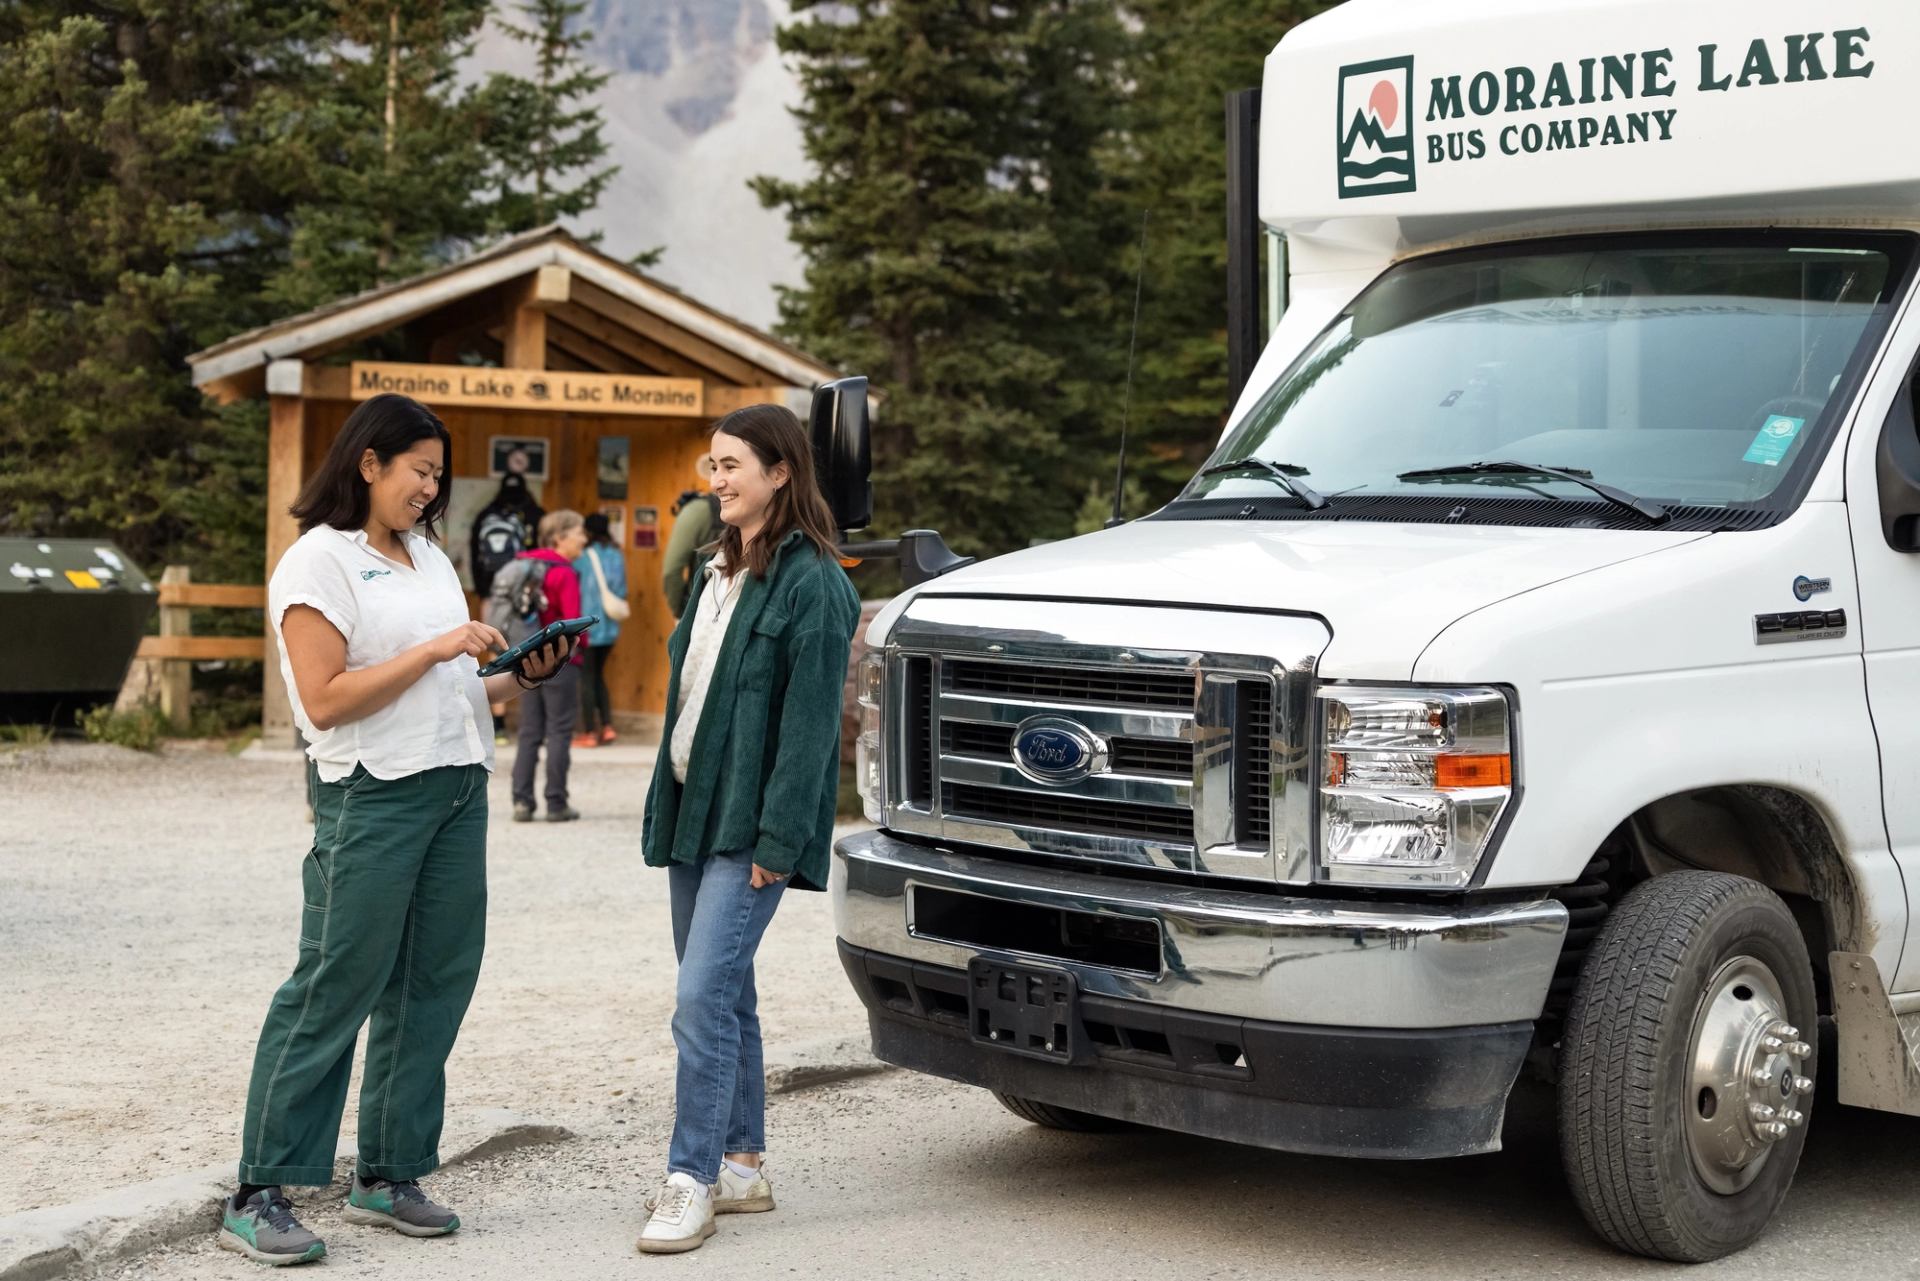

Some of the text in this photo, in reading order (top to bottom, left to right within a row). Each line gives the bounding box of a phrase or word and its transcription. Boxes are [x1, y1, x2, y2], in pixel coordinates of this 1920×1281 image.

[1425, 26, 1875, 122] MORAINE LAKE
[1426, 108, 1678, 164] BUS COMPANY
[359, 371, 696, 407] Moraine Lake Lac Moraine
[1797, 630, 1844, 640] SUPER DUTY
[1028, 734, 1068, 762] Ford
